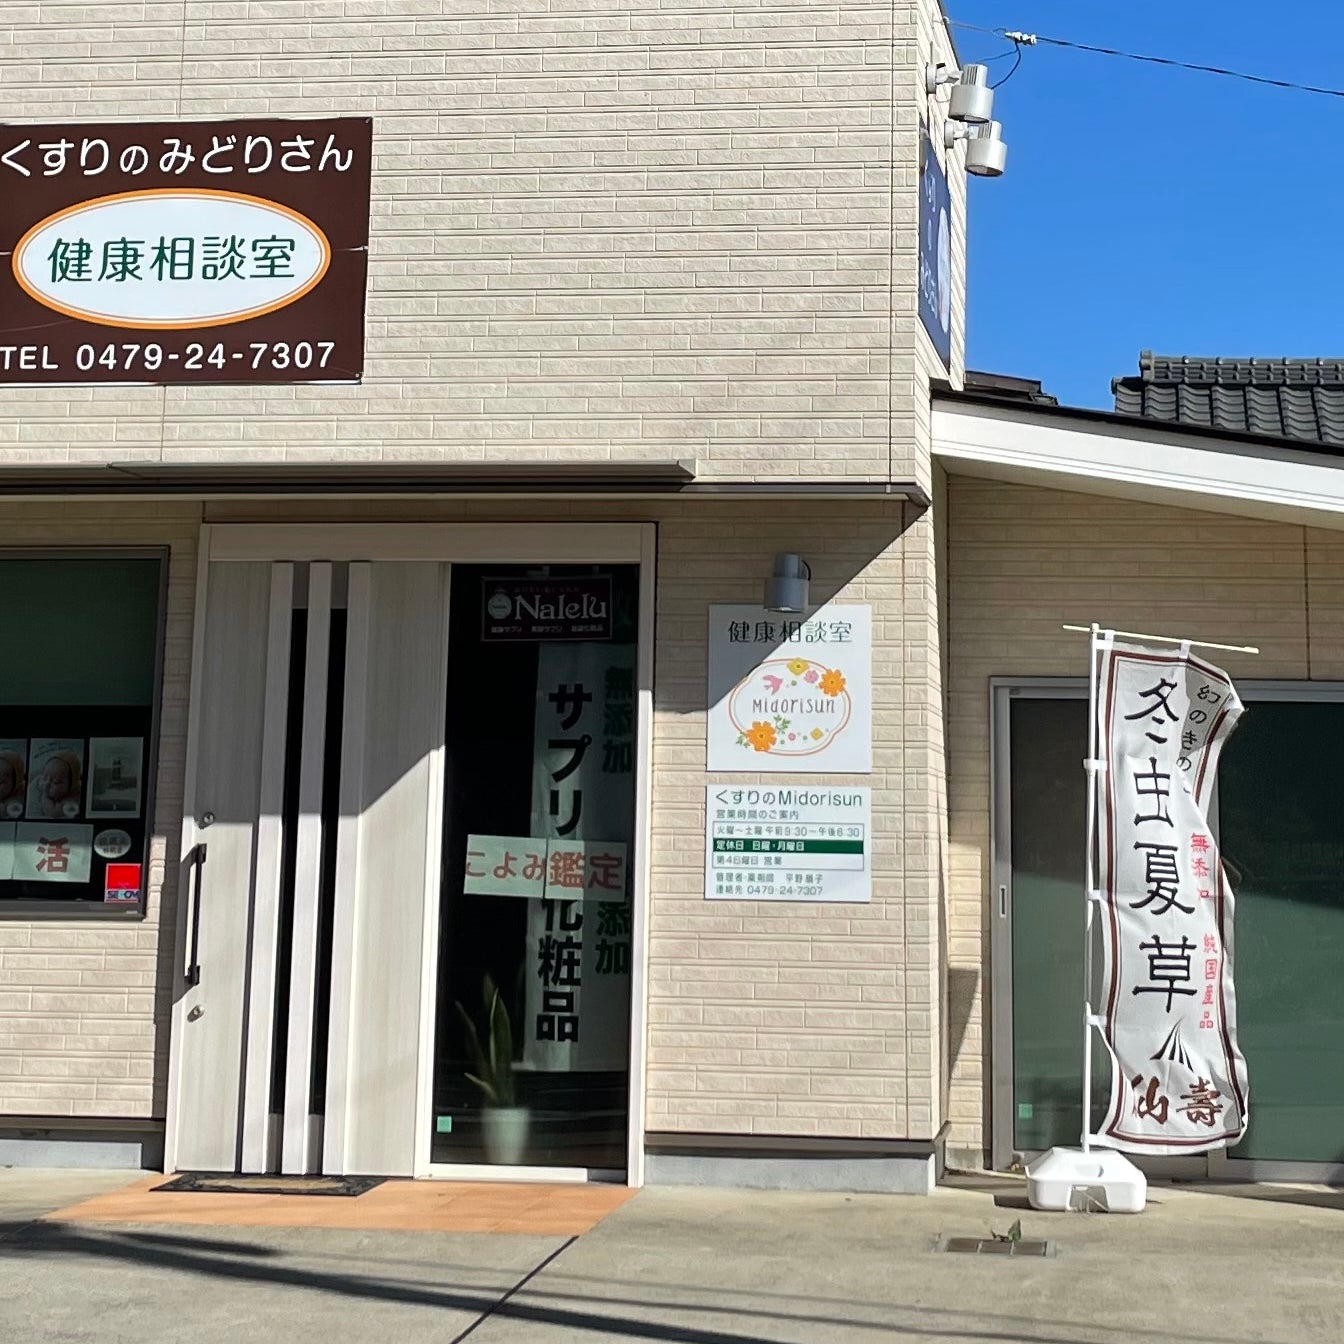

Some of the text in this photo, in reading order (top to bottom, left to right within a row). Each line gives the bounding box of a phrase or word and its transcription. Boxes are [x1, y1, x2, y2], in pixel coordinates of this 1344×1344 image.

[0, 134, 353, 176] くすりのみどりさん
[47, 234, 296, 283] 健康相談室
[0, 341, 336, 370] TEL 0479-24-7307
[728, 620, 854, 643] 健康相談室
[752, 698, 835, 714] Midorisun
[716, 789, 863, 807] くすりのMidorisun
[716, 810, 799, 820] 営業時間のご案内
[716, 840, 744, 851] 定休日
[464, 850, 623, 890] こよみ鑑定
[536, 683, 592, 1042] サプリ 化粧品
